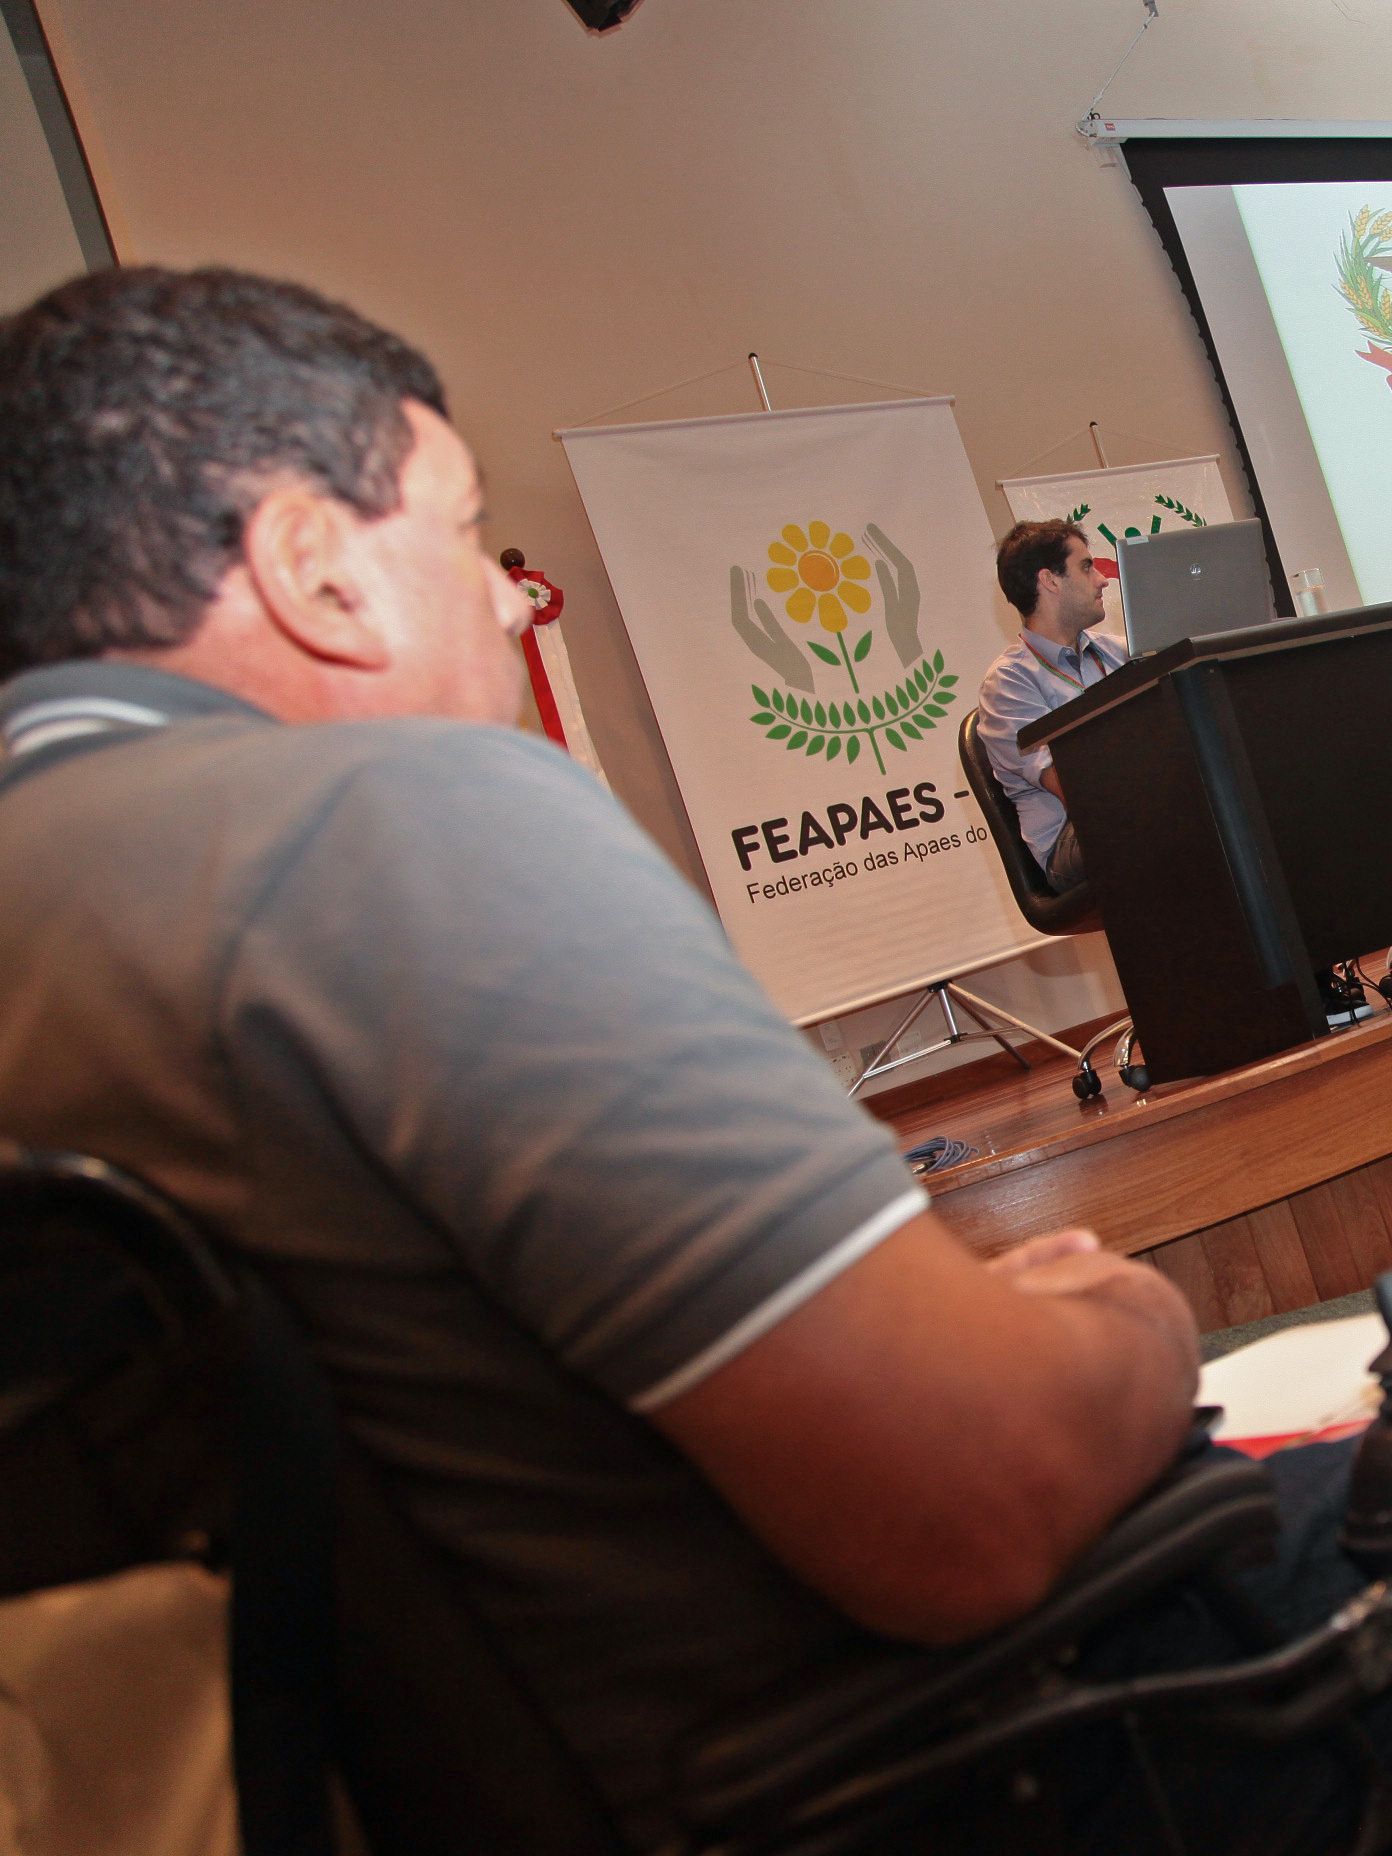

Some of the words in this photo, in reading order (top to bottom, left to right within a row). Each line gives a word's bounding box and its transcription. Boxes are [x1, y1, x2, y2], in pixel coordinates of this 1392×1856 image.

[731, 782, 945, 872] FEAPAES
[746, 860, 859, 904] Federação
[863, 848, 899, 872] das
[903, 834, 962, 863] Apaes
[965, 824, 988, 845] do
